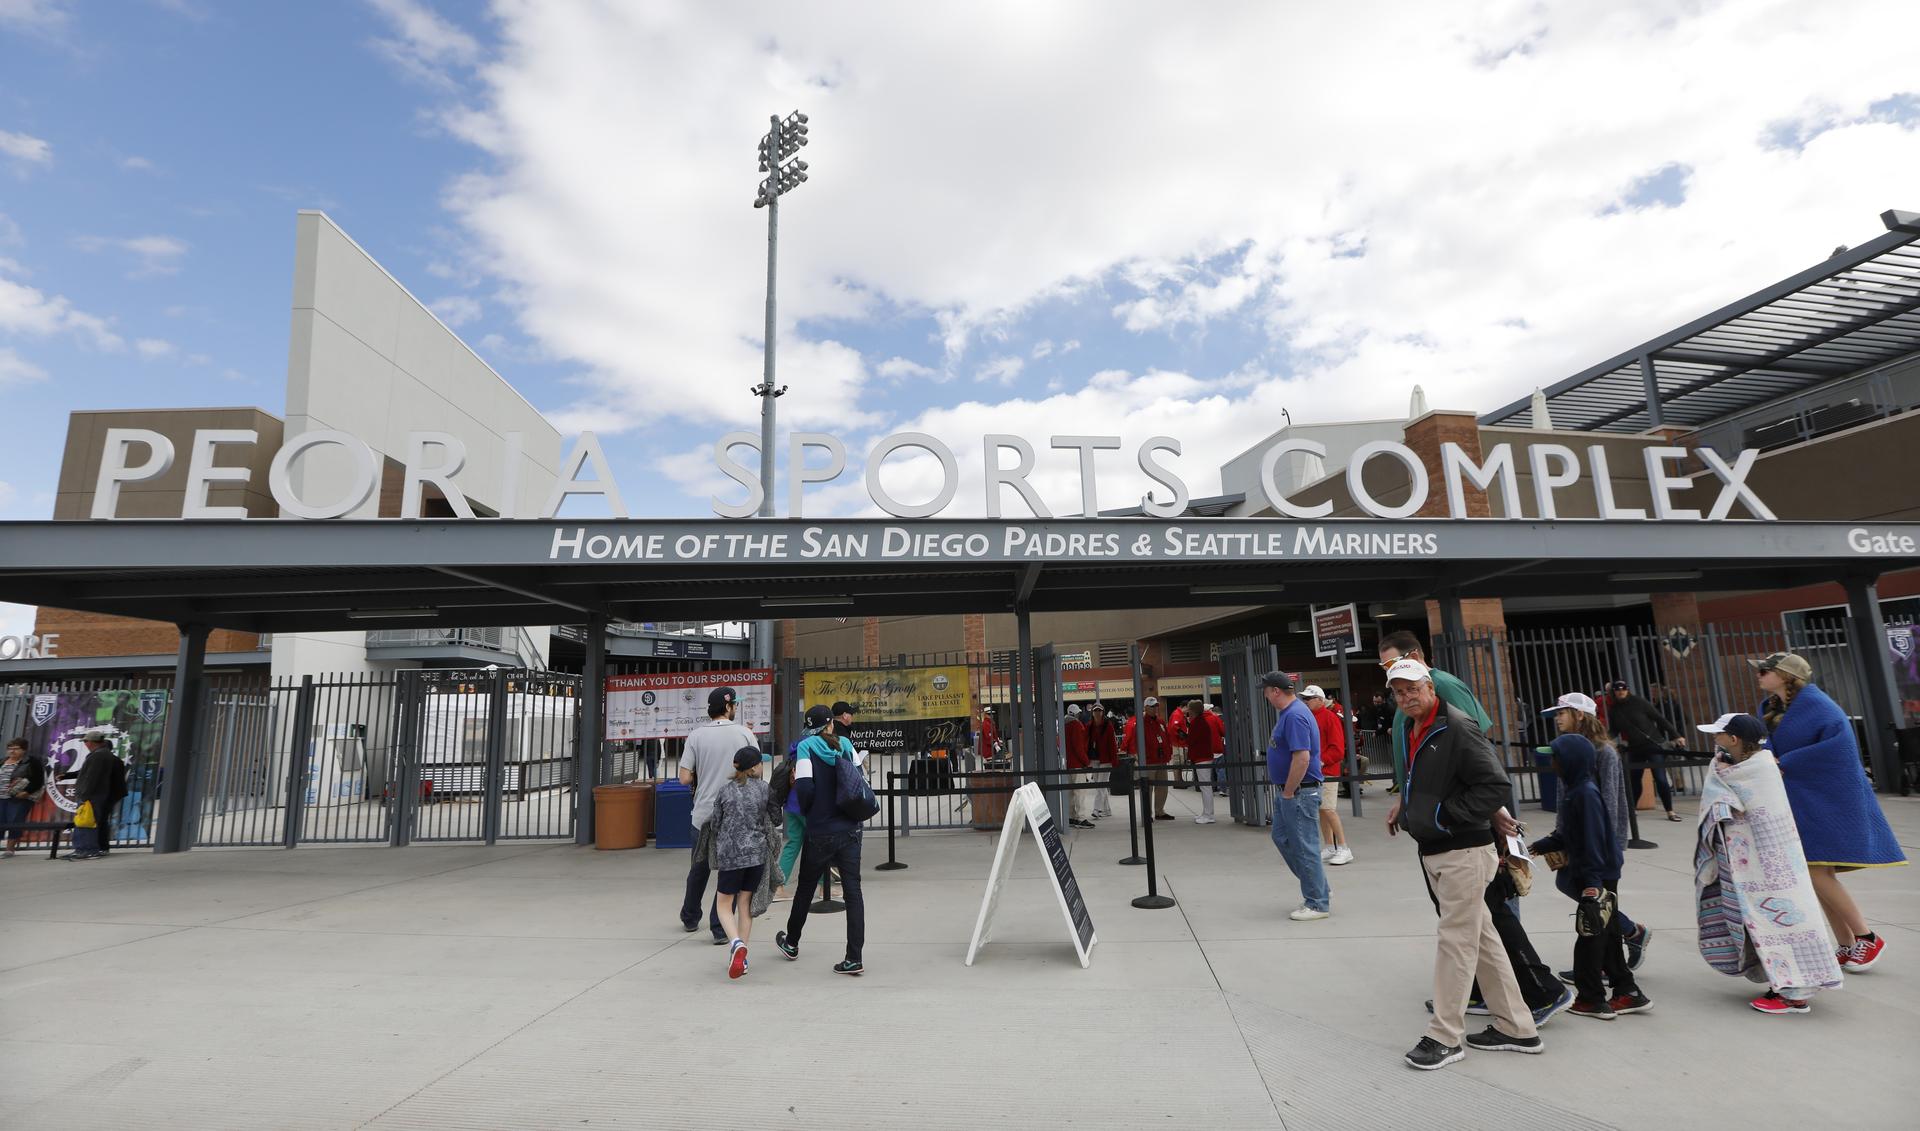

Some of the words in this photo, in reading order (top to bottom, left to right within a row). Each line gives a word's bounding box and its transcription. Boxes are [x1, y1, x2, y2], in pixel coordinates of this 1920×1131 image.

[90, 427, 630, 520] PEORIA
[712, 431, 1191, 519] SPORTS
[1260, 440, 1779, 520] COMPLEX
[550, 528, 664, 559] HOME
[675, 535, 720, 558] OF
[719, 534, 787, 558] THE
[800, 527, 869, 558] SAN
[881, 527, 989, 557] DIEGO
[1003, 526, 1119, 557] PADRES
[1131, 533, 1152, 556] &
[1164, 526, 1283, 556] SEATTLE
[1293, 527, 1438, 555] MARINERS
[1848, 528, 1917, 553] Gate
[649, 677, 669, 686] YOU
[672, 676, 685, 685] TO
[687, 675, 708, 684] OUR
[813, 680, 836, 695] The
[840, 680, 877, 695] Worth
[935, 692, 964, 700] PLEASANT
[850, 730, 874, 739] North
[876, 729, 902, 738] Peoria
[870, 739, 904, 748] Realtors
